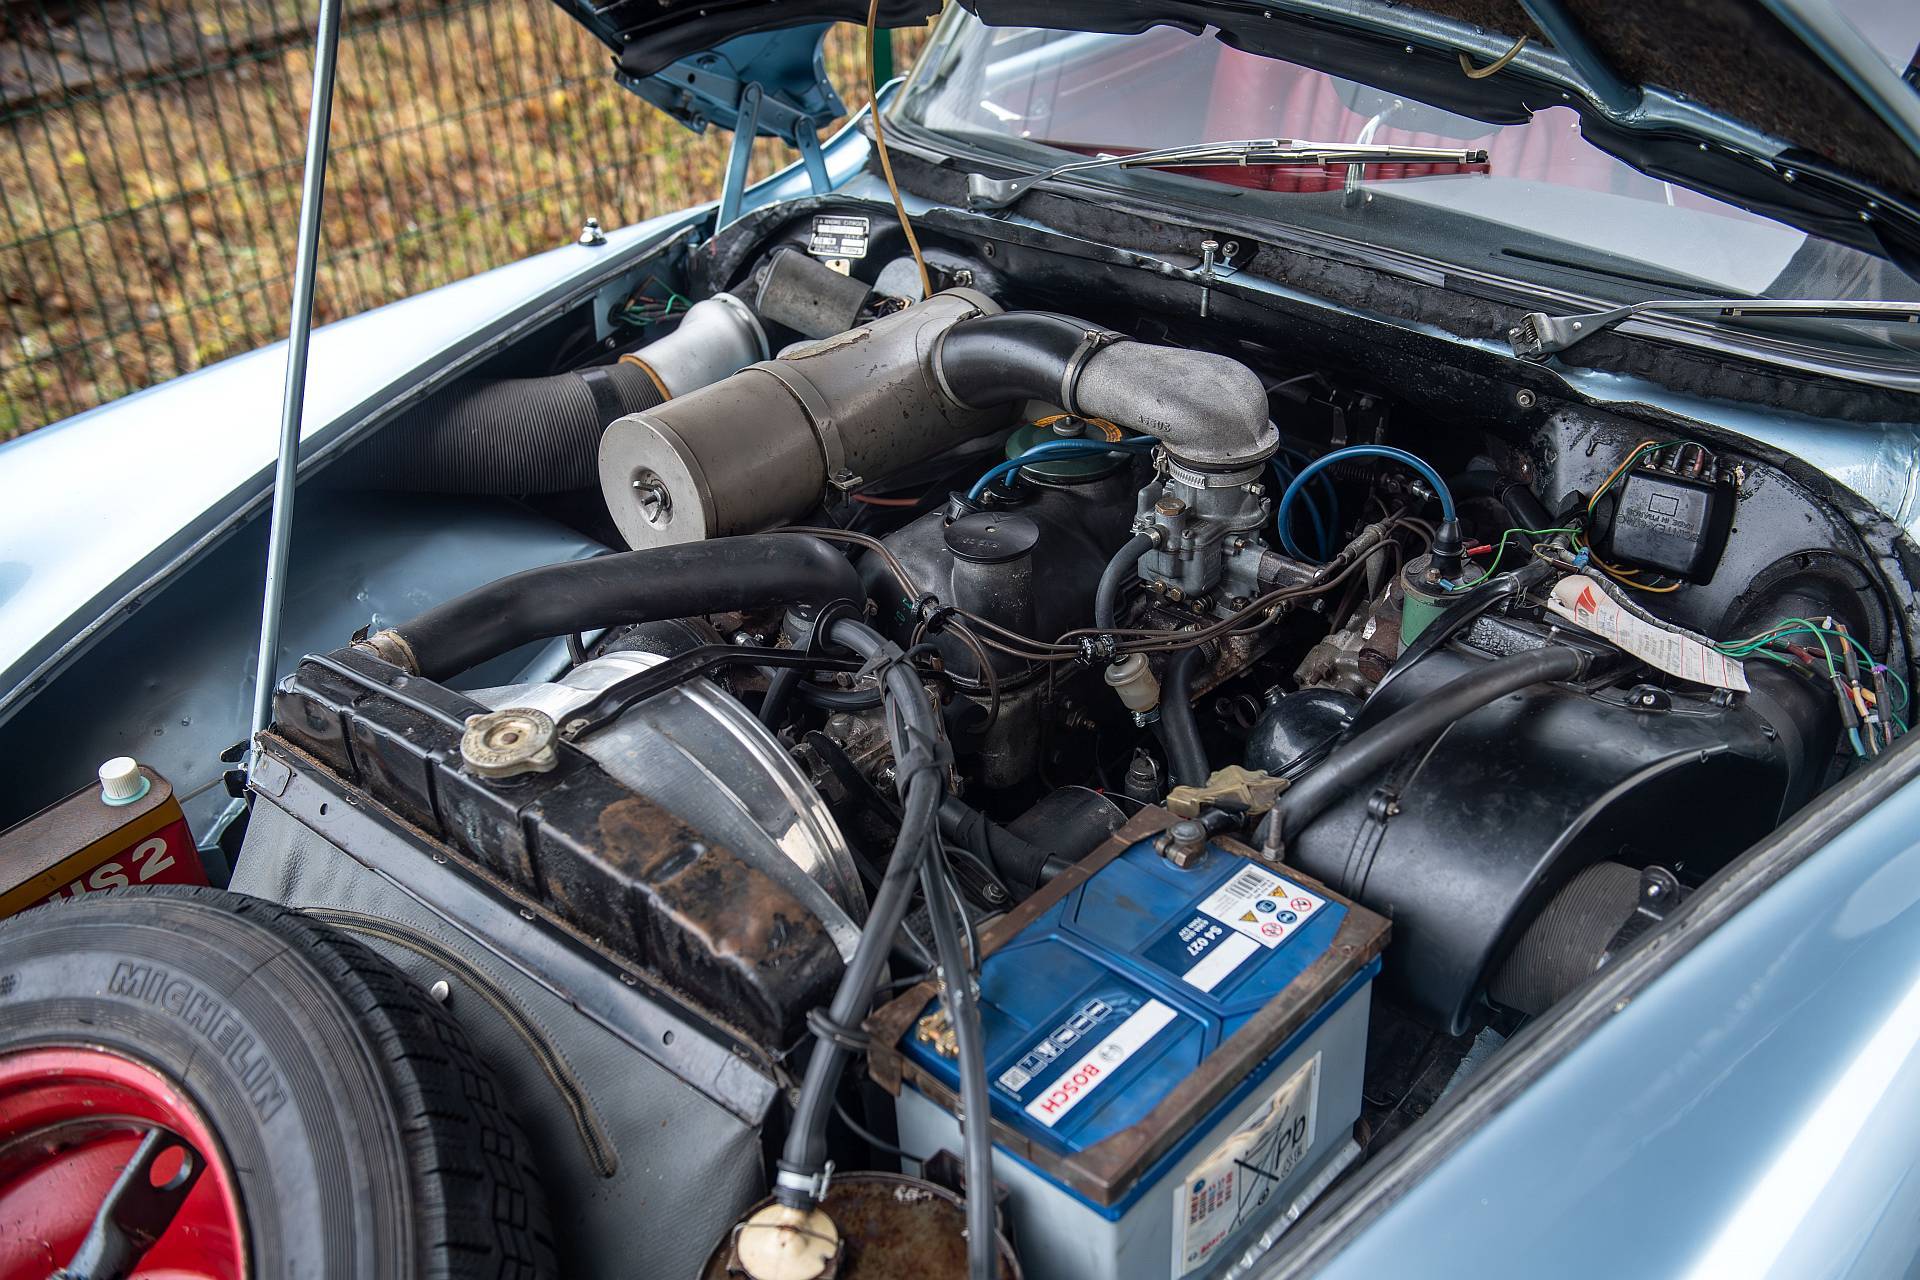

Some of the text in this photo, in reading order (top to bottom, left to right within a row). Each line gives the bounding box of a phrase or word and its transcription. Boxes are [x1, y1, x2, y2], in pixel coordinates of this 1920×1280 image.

[1186, 937, 1209, 957] 027
[107, 961, 288, 1125] MICHELIN
[1041, 1063, 1100, 1114] BOSCH
[1275, 1114, 1306, 1171] Pb
